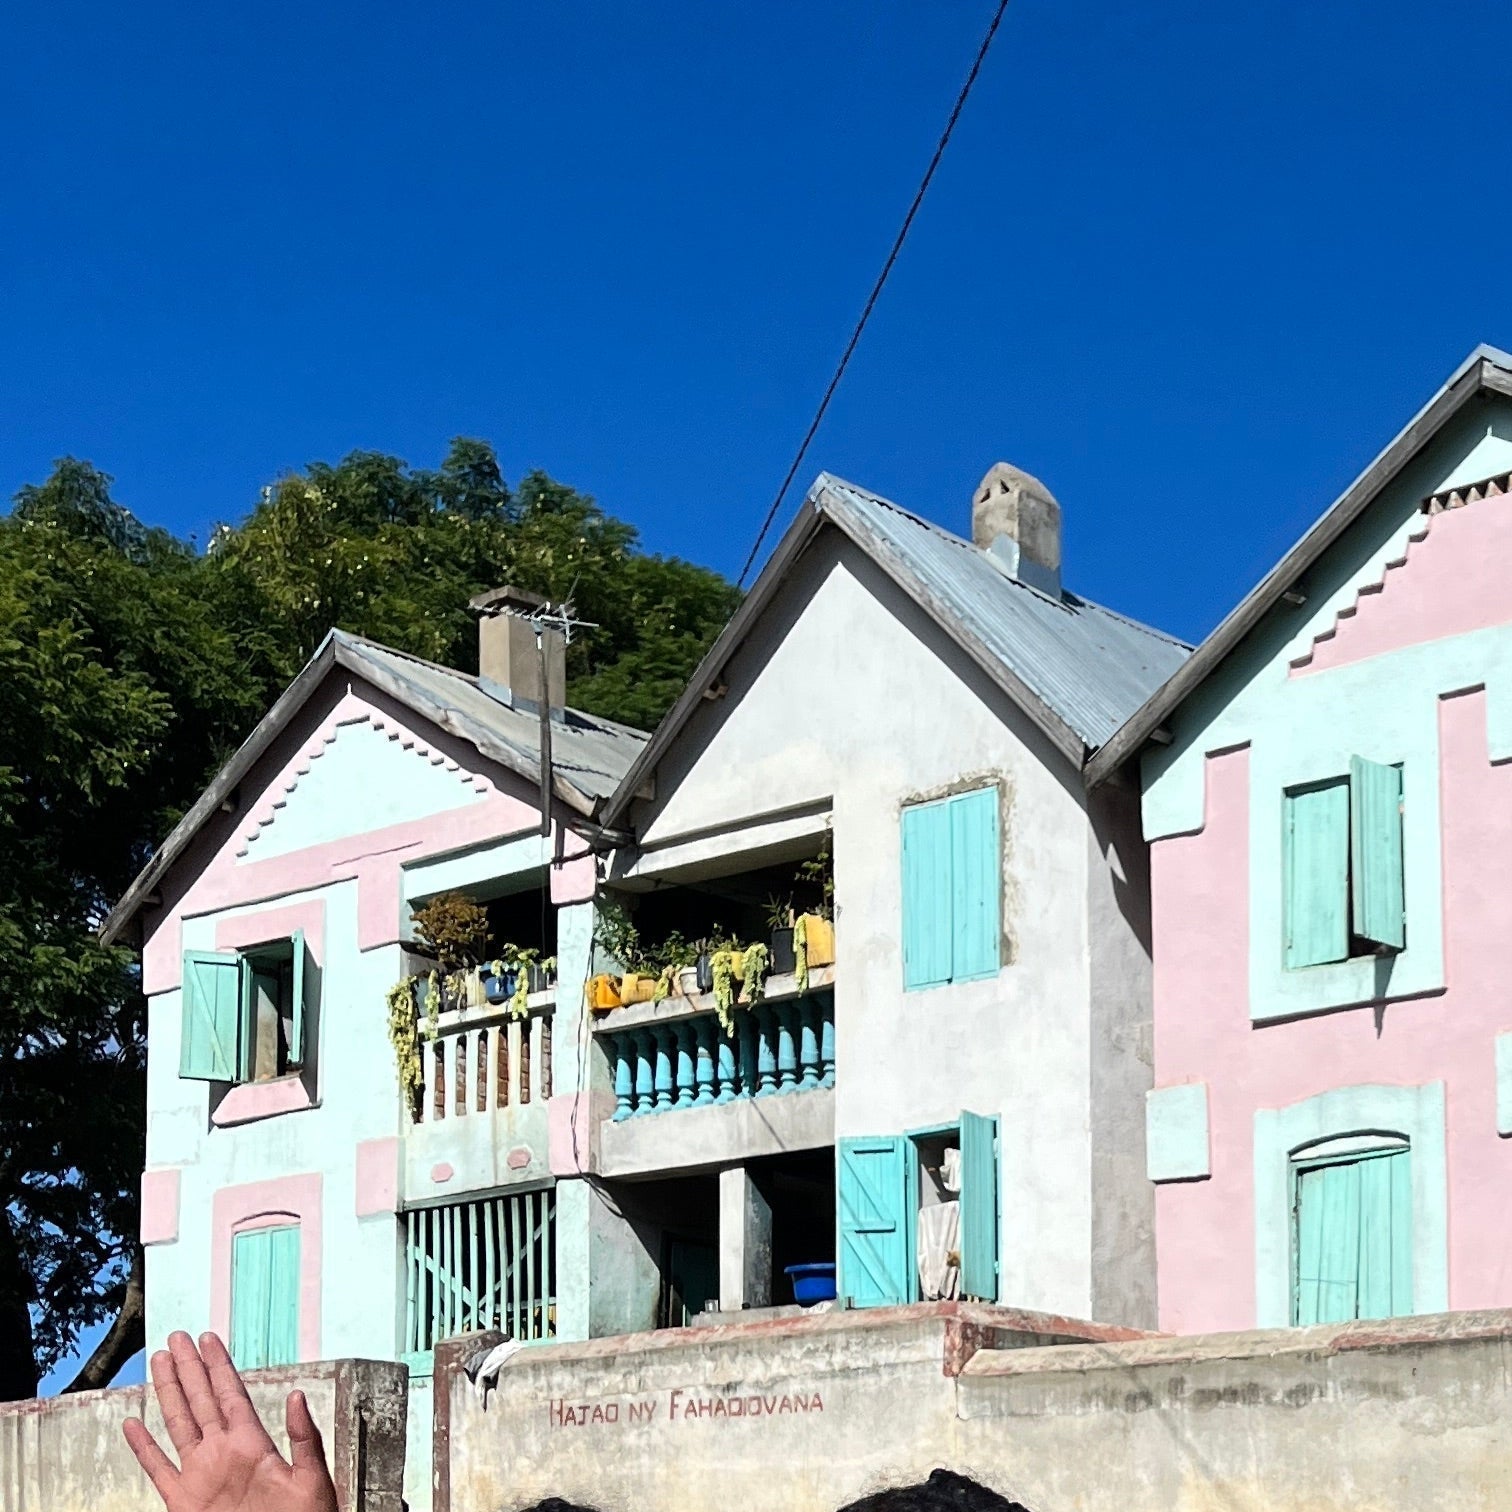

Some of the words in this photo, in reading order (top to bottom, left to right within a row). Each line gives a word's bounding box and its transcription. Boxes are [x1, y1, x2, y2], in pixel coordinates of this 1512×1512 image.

[549, 1398, 619, 1427] HAJAO
[628, 1400, 656, 1423] NY
[669, 1390, 824, 1420] FAHADIOVANA
